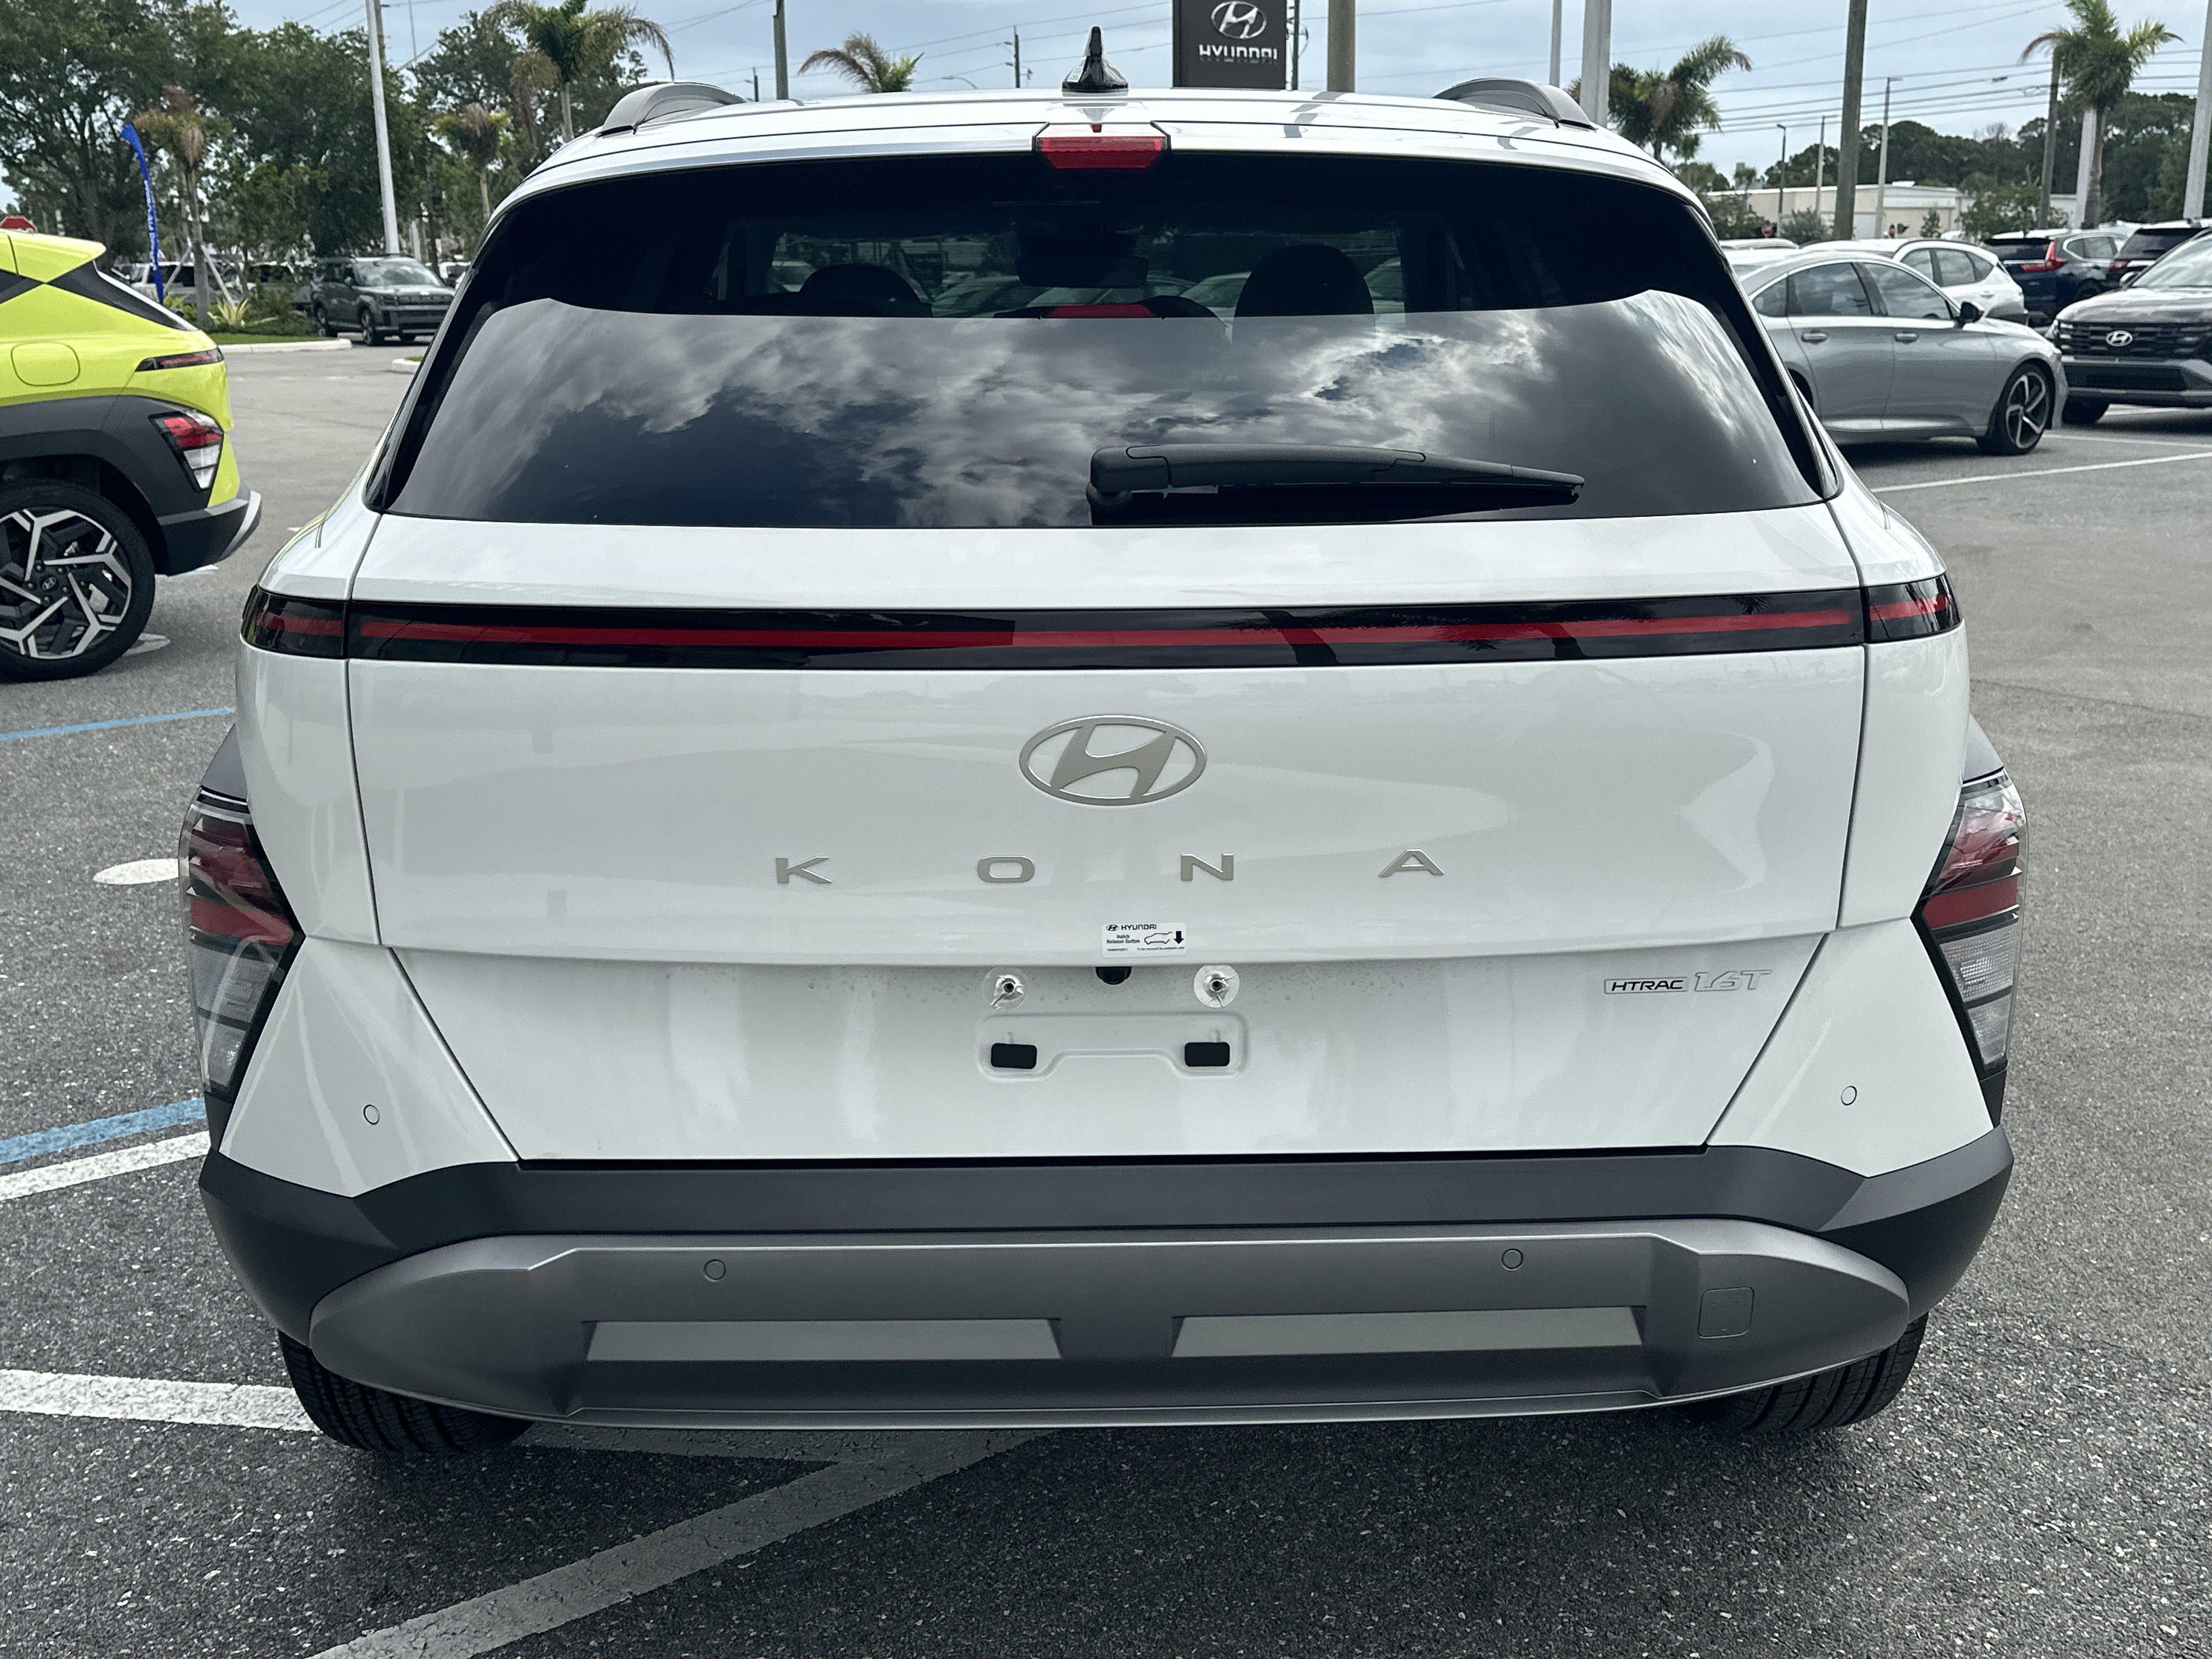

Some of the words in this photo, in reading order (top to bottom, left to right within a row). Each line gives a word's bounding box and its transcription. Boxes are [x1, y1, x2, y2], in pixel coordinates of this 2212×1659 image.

[1199, 44, 1278, 64] HYUNDAI
[776, 849, 1444, 884] KONA
[1611, 980, 1683, 991] HTRAC
